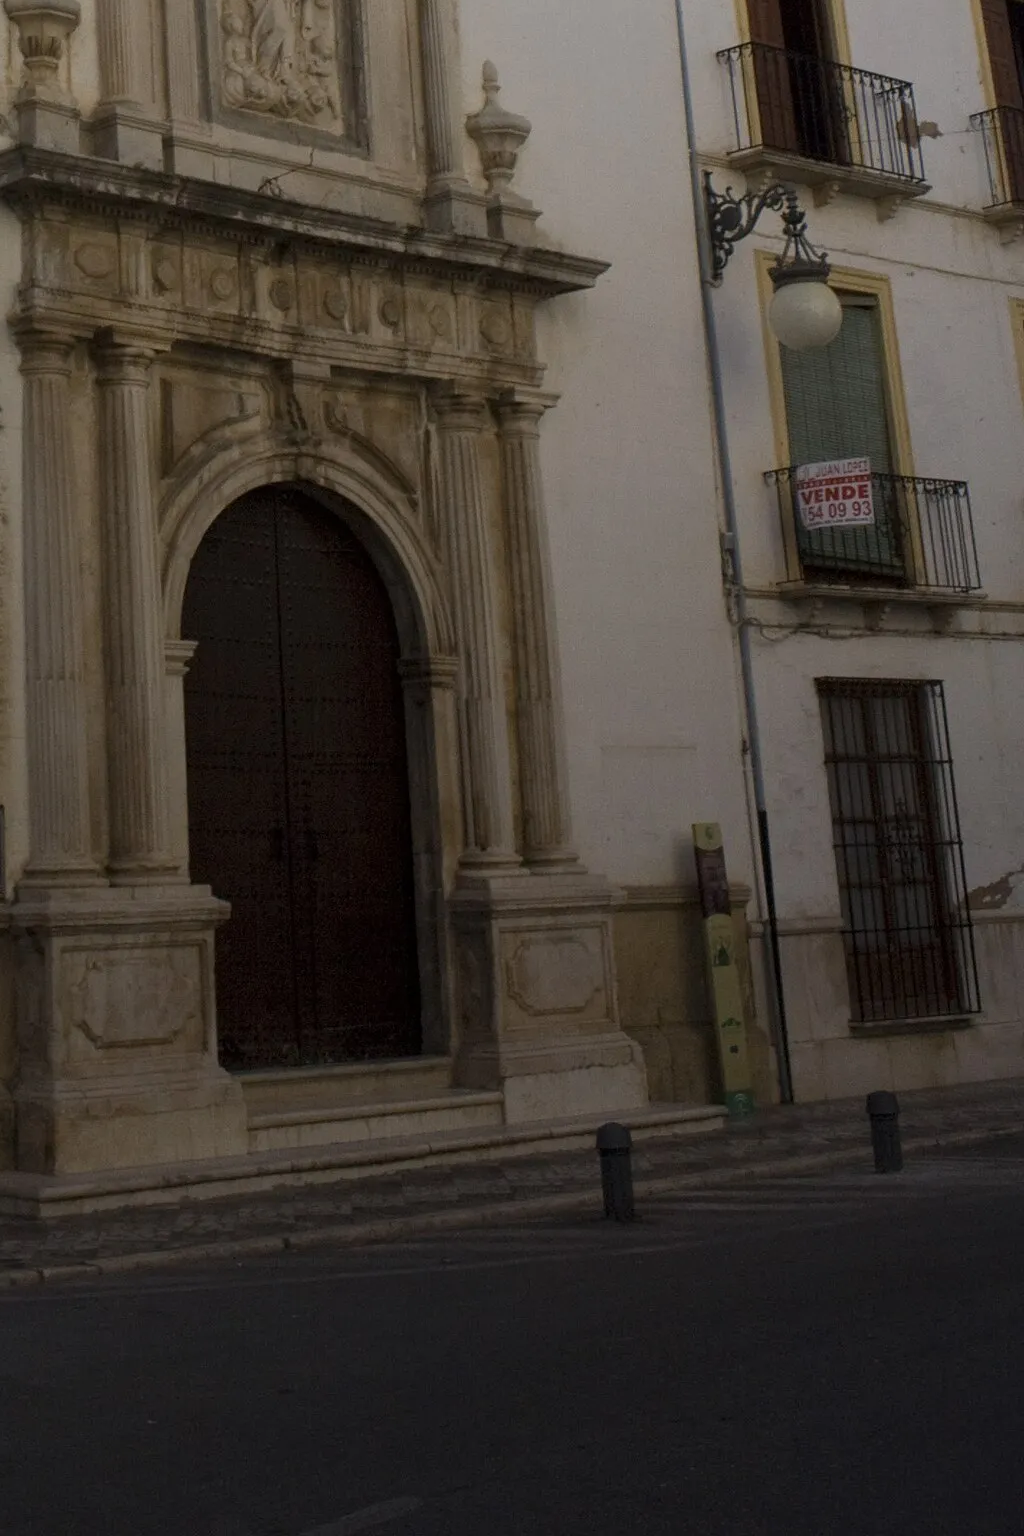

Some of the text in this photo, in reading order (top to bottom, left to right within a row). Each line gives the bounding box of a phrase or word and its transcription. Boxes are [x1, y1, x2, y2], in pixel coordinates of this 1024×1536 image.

[801, 484, 869, 506] VENDE
[808, 505, 824, 522] 54
[828, 502, 846, 518] 09
[852, 501, 872, 517] 93
